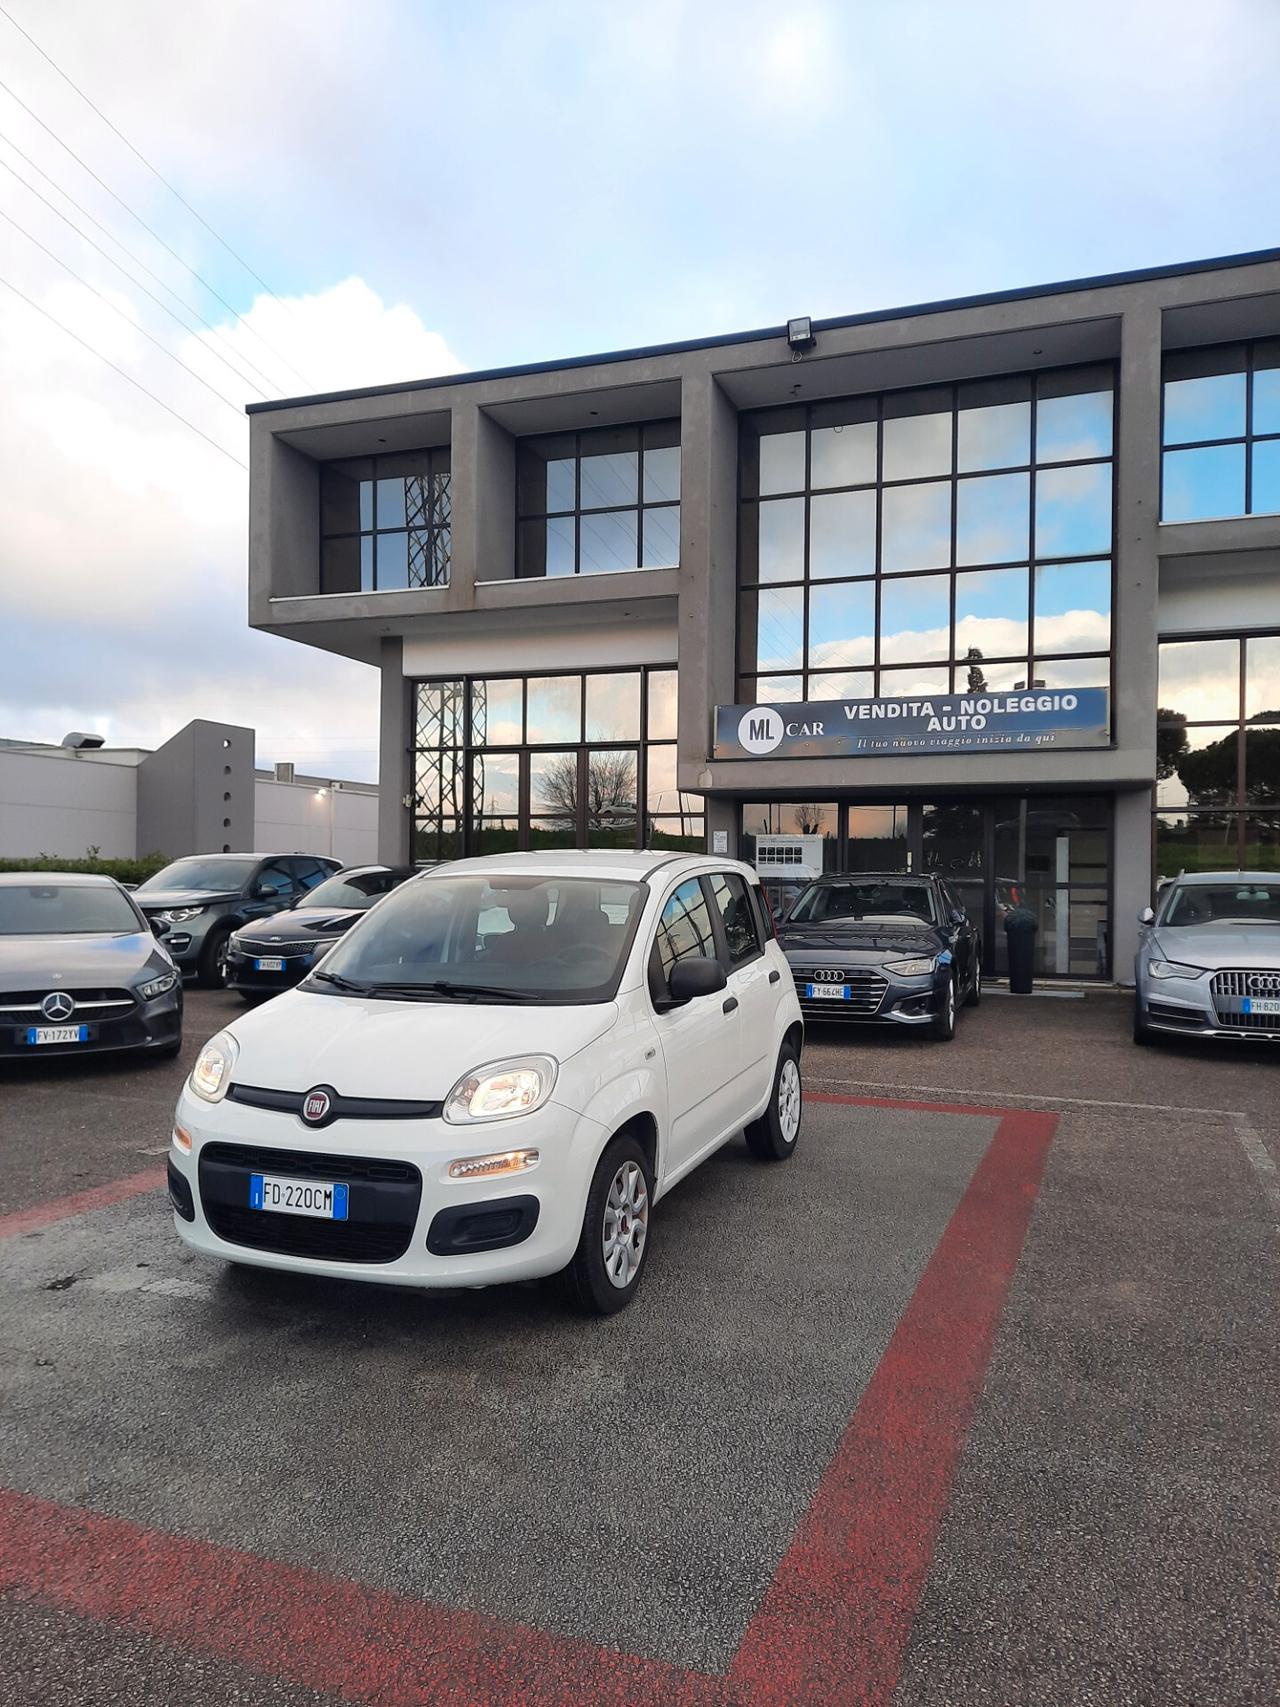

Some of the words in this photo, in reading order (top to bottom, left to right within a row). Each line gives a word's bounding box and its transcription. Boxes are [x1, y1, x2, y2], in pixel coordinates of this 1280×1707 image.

[844, 702, 935, 720] VENDITA
[960, 694, 1078, 715] NOLEGGIO
[749, 718, 775, 741] ML
[785, 722, 824, 737] CAR
[927, 714, 987, 732] AUTO
[857, 738, 867, 749] Il
[870, 740, 888, 748] tuo
[892, 739, 926, 748] nuovo
[930, 736, 972, 748] viaggio
[976, 734, 1012, 745] inizia
[1035, 731, 1056, 745] qui
[307, 1099, 325, 1114] FIAT
